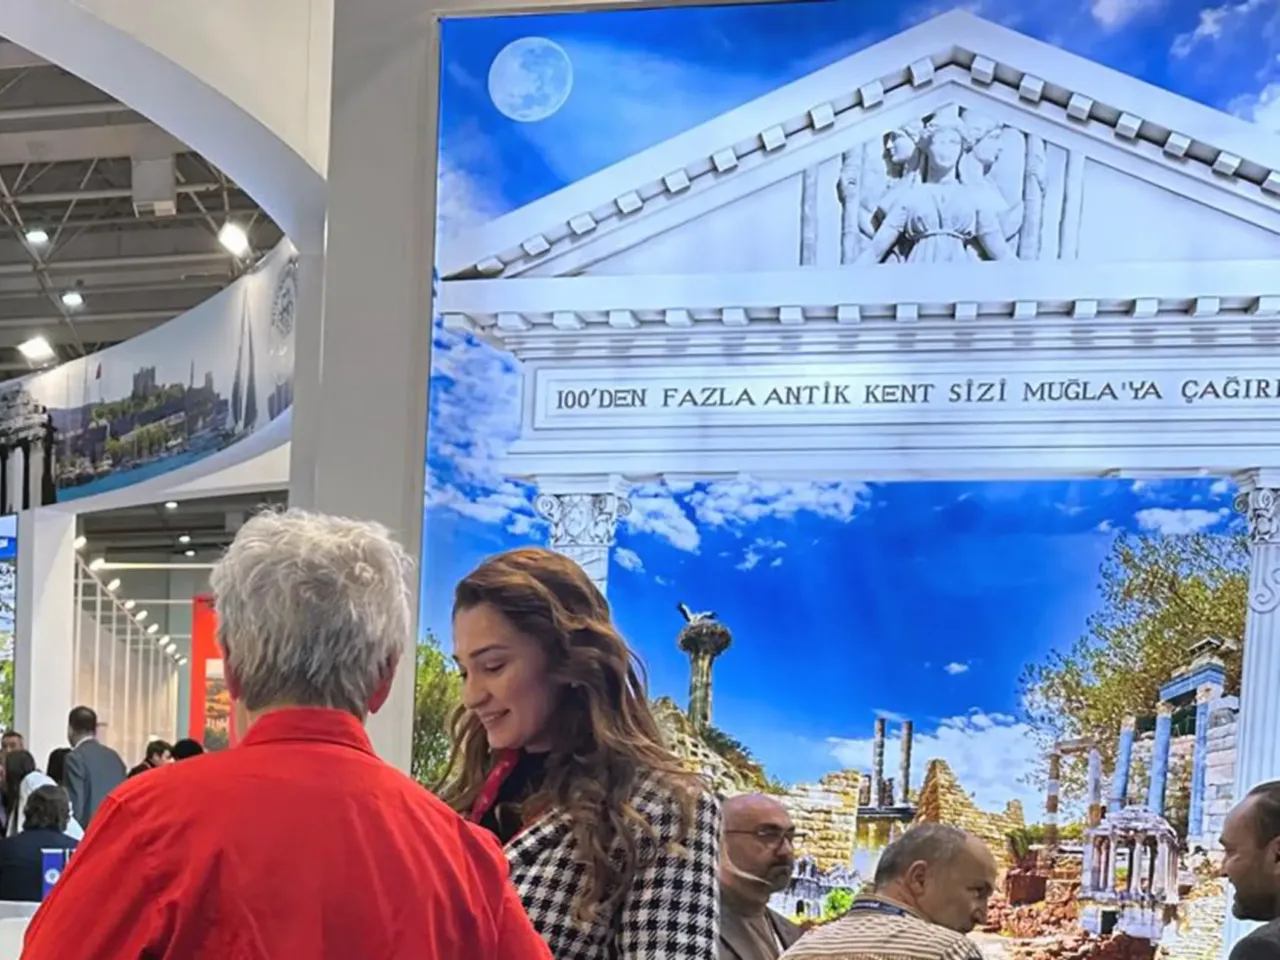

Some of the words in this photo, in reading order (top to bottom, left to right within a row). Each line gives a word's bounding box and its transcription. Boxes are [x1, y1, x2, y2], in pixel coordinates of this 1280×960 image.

[662, 386, 757, 408] FAZLA
[763, 380, 851, 406] ANTİK
[864, 383, 936, 404] KENT
[948, 378, 1007, 403] SİZİ
[1023, 377, 1163, 402] MUĞLA'YA
